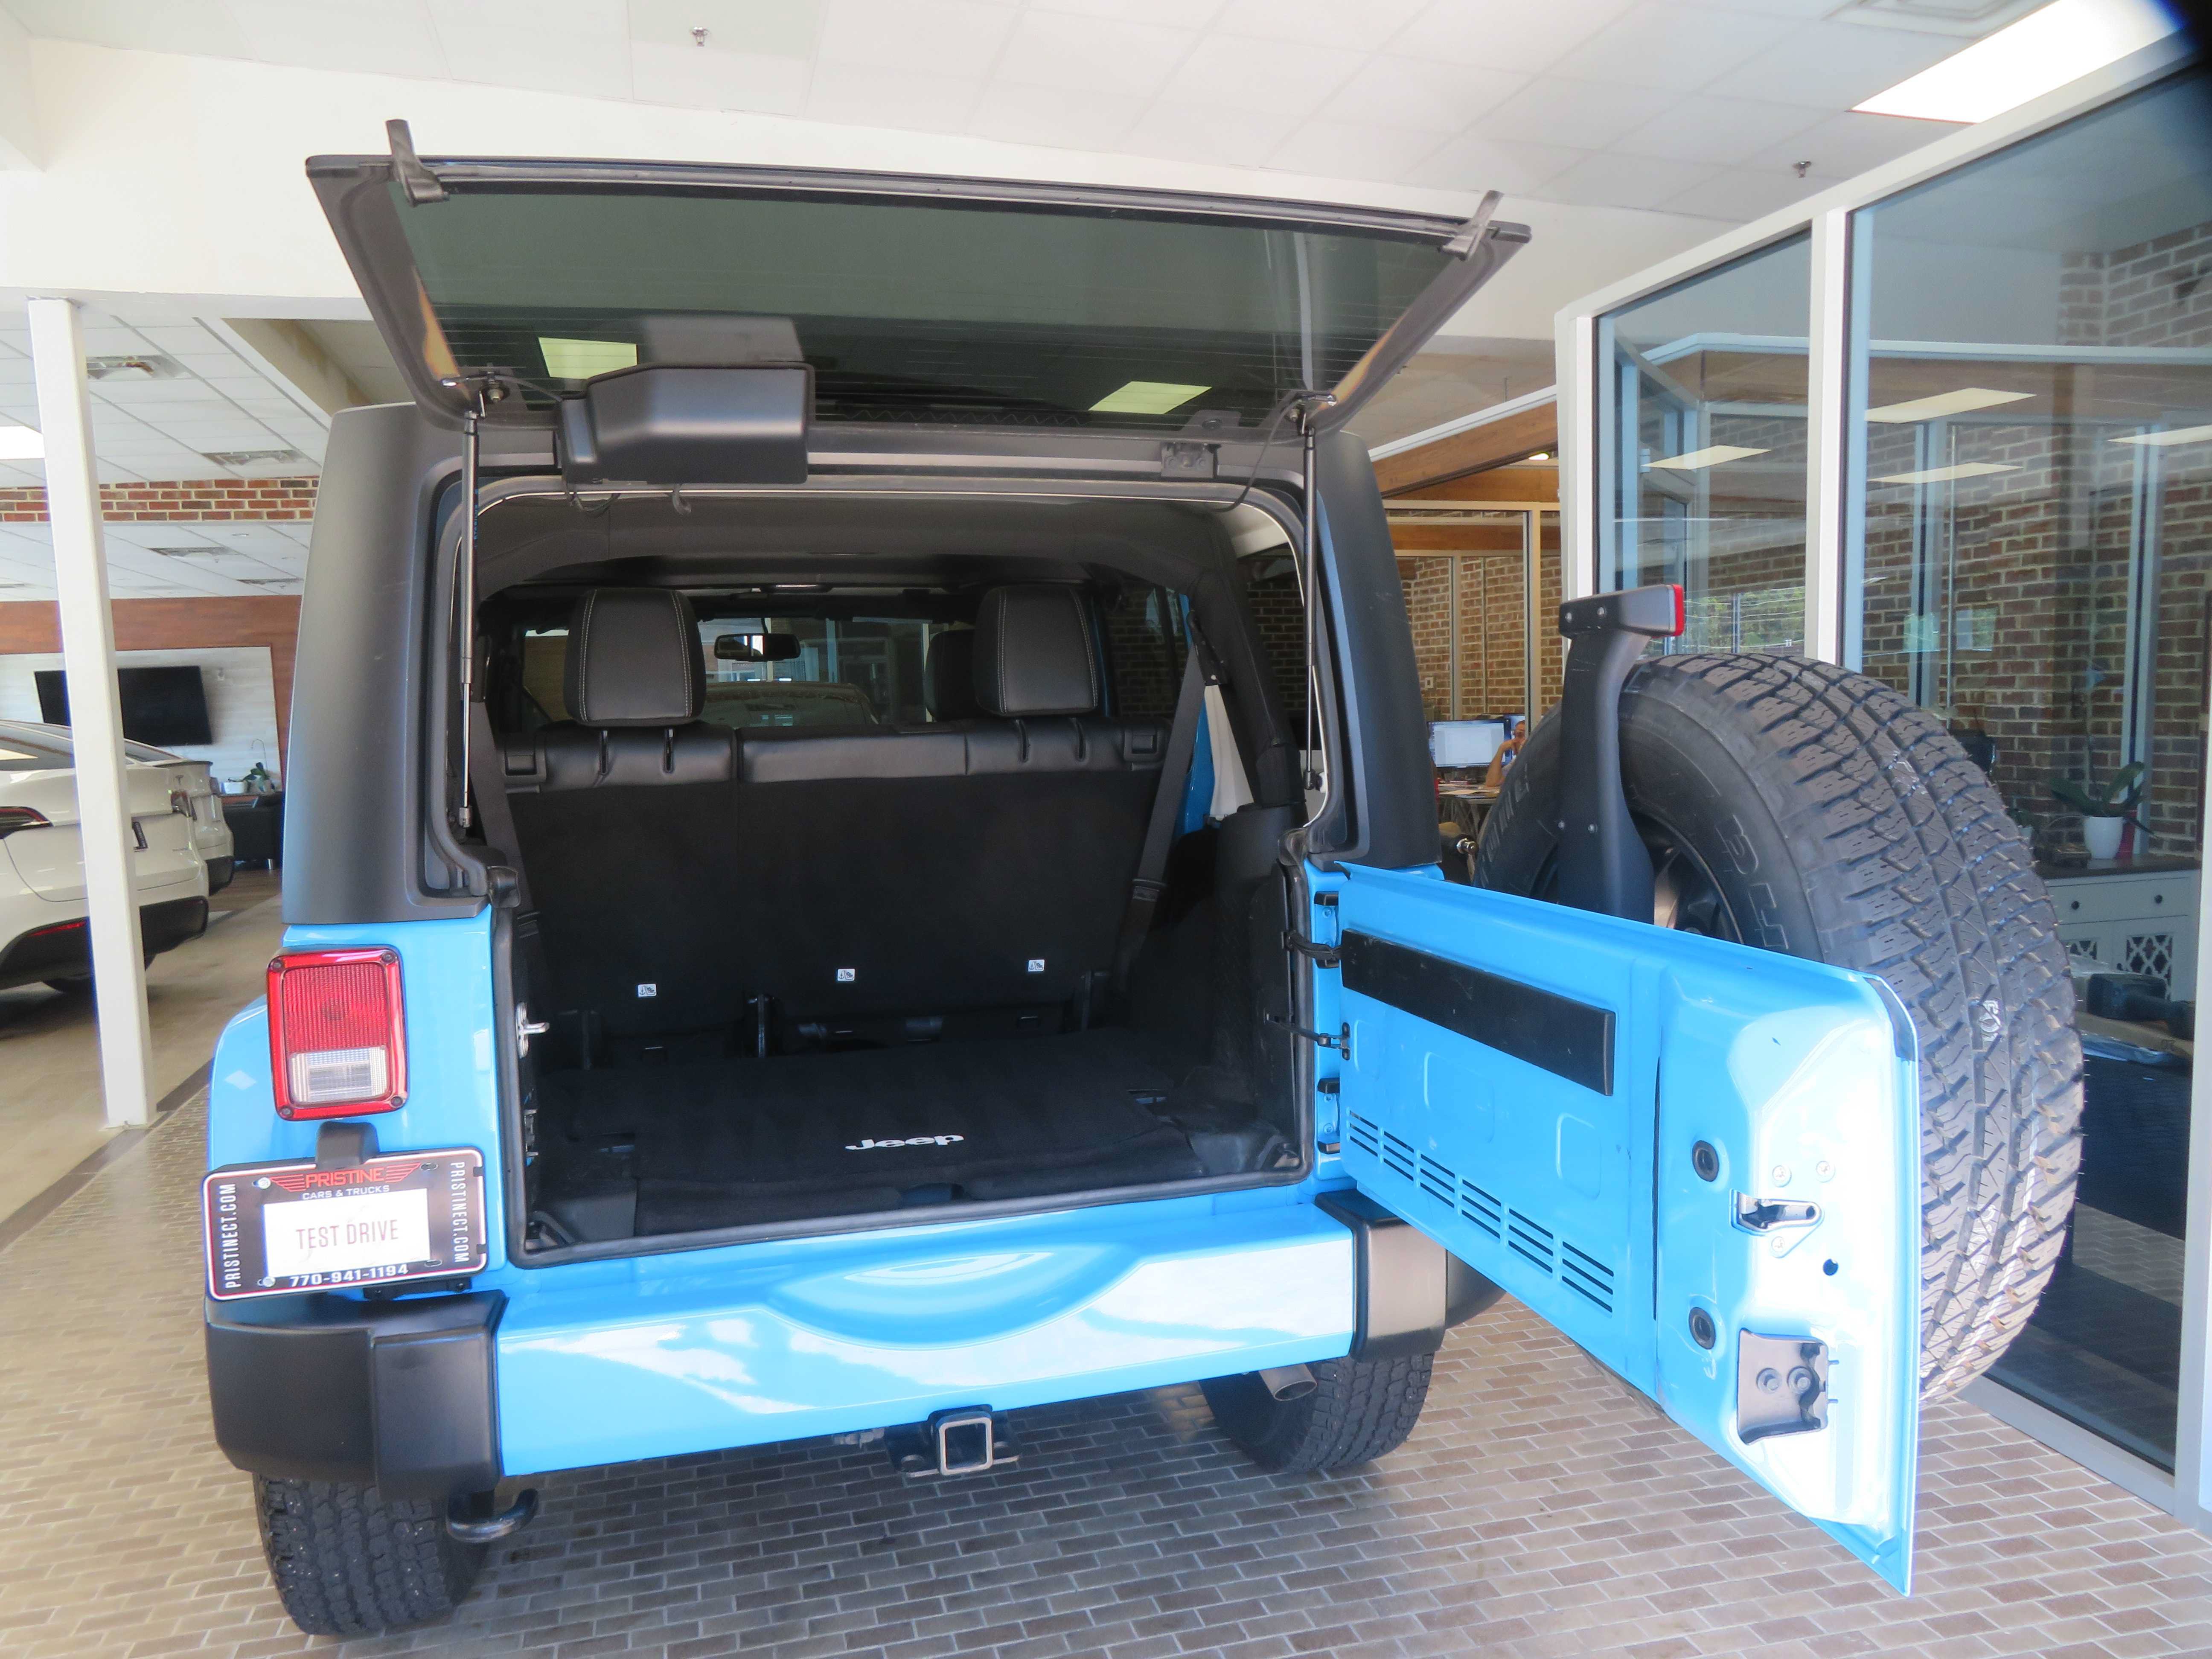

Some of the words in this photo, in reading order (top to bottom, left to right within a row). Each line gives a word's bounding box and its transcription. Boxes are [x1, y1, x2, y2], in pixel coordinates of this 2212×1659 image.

[845, 1135, 964, 1150] Jeep
[306, 1167, 384, 1188] PRISTINE
[302, 1190, 332, 1200] CARS
[335, 1189, 344, 1197] &
[346, 1185, 390, 1196] TRUCKS
[450, 1161, 470, 1263] PRISTINECT.COM
[218, 1183, 242, 1289] PRISTINECT.COM
[296, 1225, 340, 1250] TEST
[346, 1219, 399, 1245] DRIVE
[290, 1264, 409, 1287] 770-941-1194
